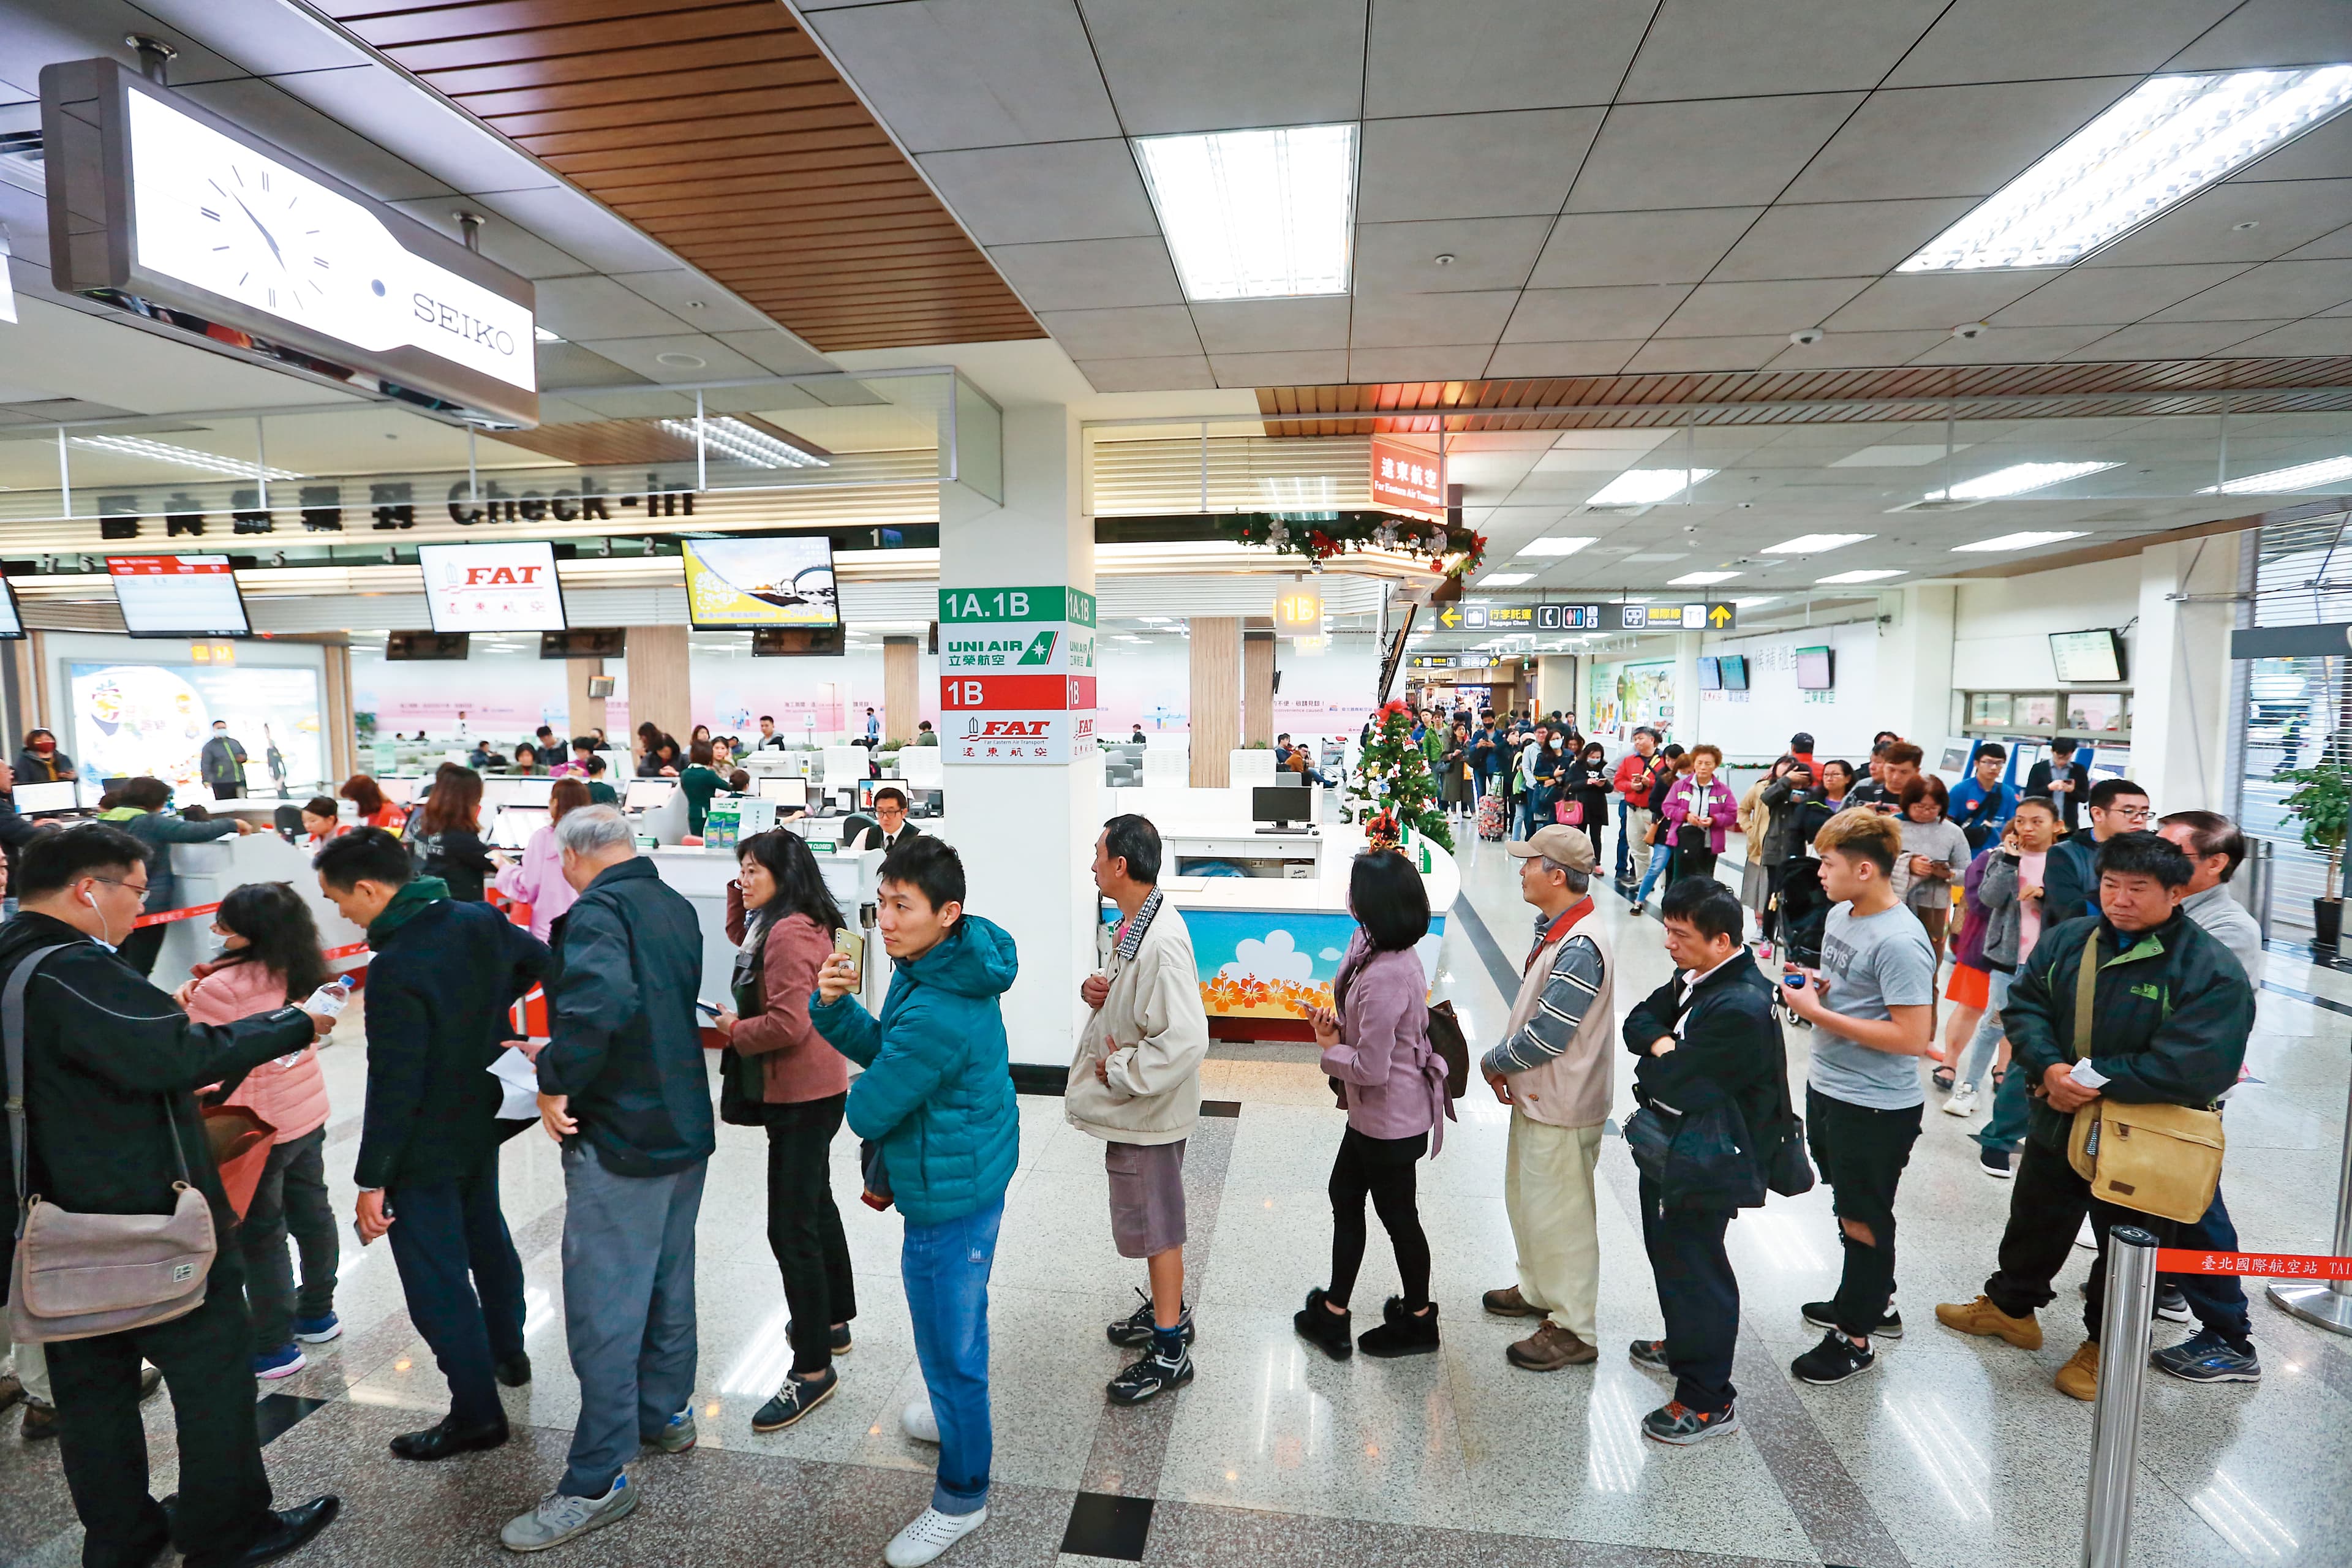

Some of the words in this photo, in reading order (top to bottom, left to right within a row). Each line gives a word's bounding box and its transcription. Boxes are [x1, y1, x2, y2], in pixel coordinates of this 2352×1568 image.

[413, 293, 514, 355] SEIKO
[1374, 480, 1384, 491] Far
[1406, 488, 1417, 499] Air
[447, 473, 693, 526] Check-in
[597, 537, 610, 556] 3
[643, 537, 655, 556] 2
[870, 528, 880, 547] 1
[465, 566, 542, 585] FAT
[945, 592, 1030, 618] 1A.1B
[1069, 593, 1089, 622] 1A.1B
[1283, 597, 1314, 621] 1B
[1489, 608, 1532, 620] 行李託運
[948, 641, 985, 653] UNI
[988, 639, 1023, 652] AIR
[1069, 640, 1079, 652] UNI
[1079, 643, 1088, 654] AIR
[948, 654, 1005, 666] 立榮航空
[947, 680, 984, 706] 1B
[1069, 680, 1079, 705] 1B
[982, 720, 1051, 736] FAT
[1078, 718, 1093, 734] FAT
[2201, 1254, 2318, 1275] 臺北國際航空站
